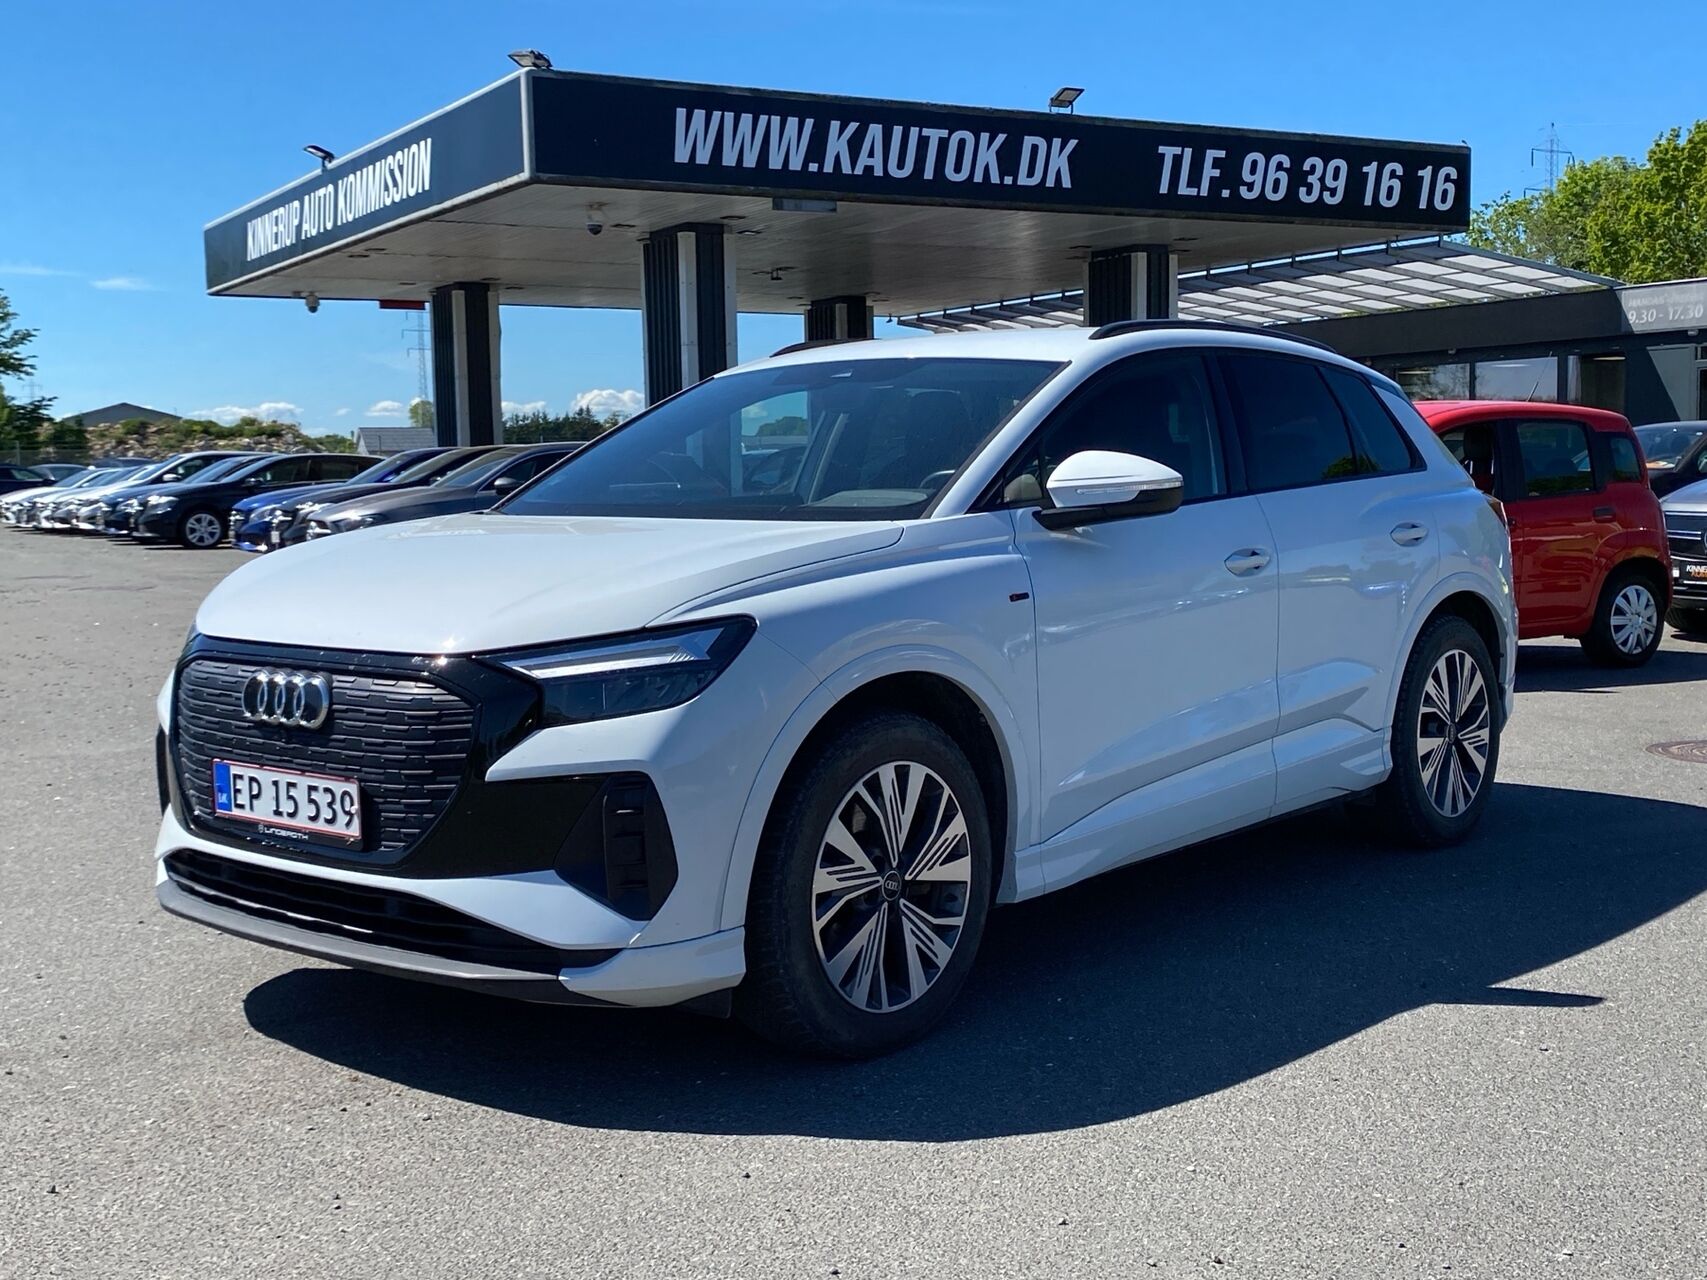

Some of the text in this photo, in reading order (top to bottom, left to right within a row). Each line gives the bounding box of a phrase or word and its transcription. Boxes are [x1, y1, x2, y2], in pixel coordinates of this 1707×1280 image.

[674, 107, 1078, 188] WWW.KAUTOK.DK
[1158, 146, 1458, 211] TLF. 96 39 16 16
[247, 138, 432, 261] KINNERUP AUTO KOMMISSION
[232, 773, 355, 829] EP 15 539
